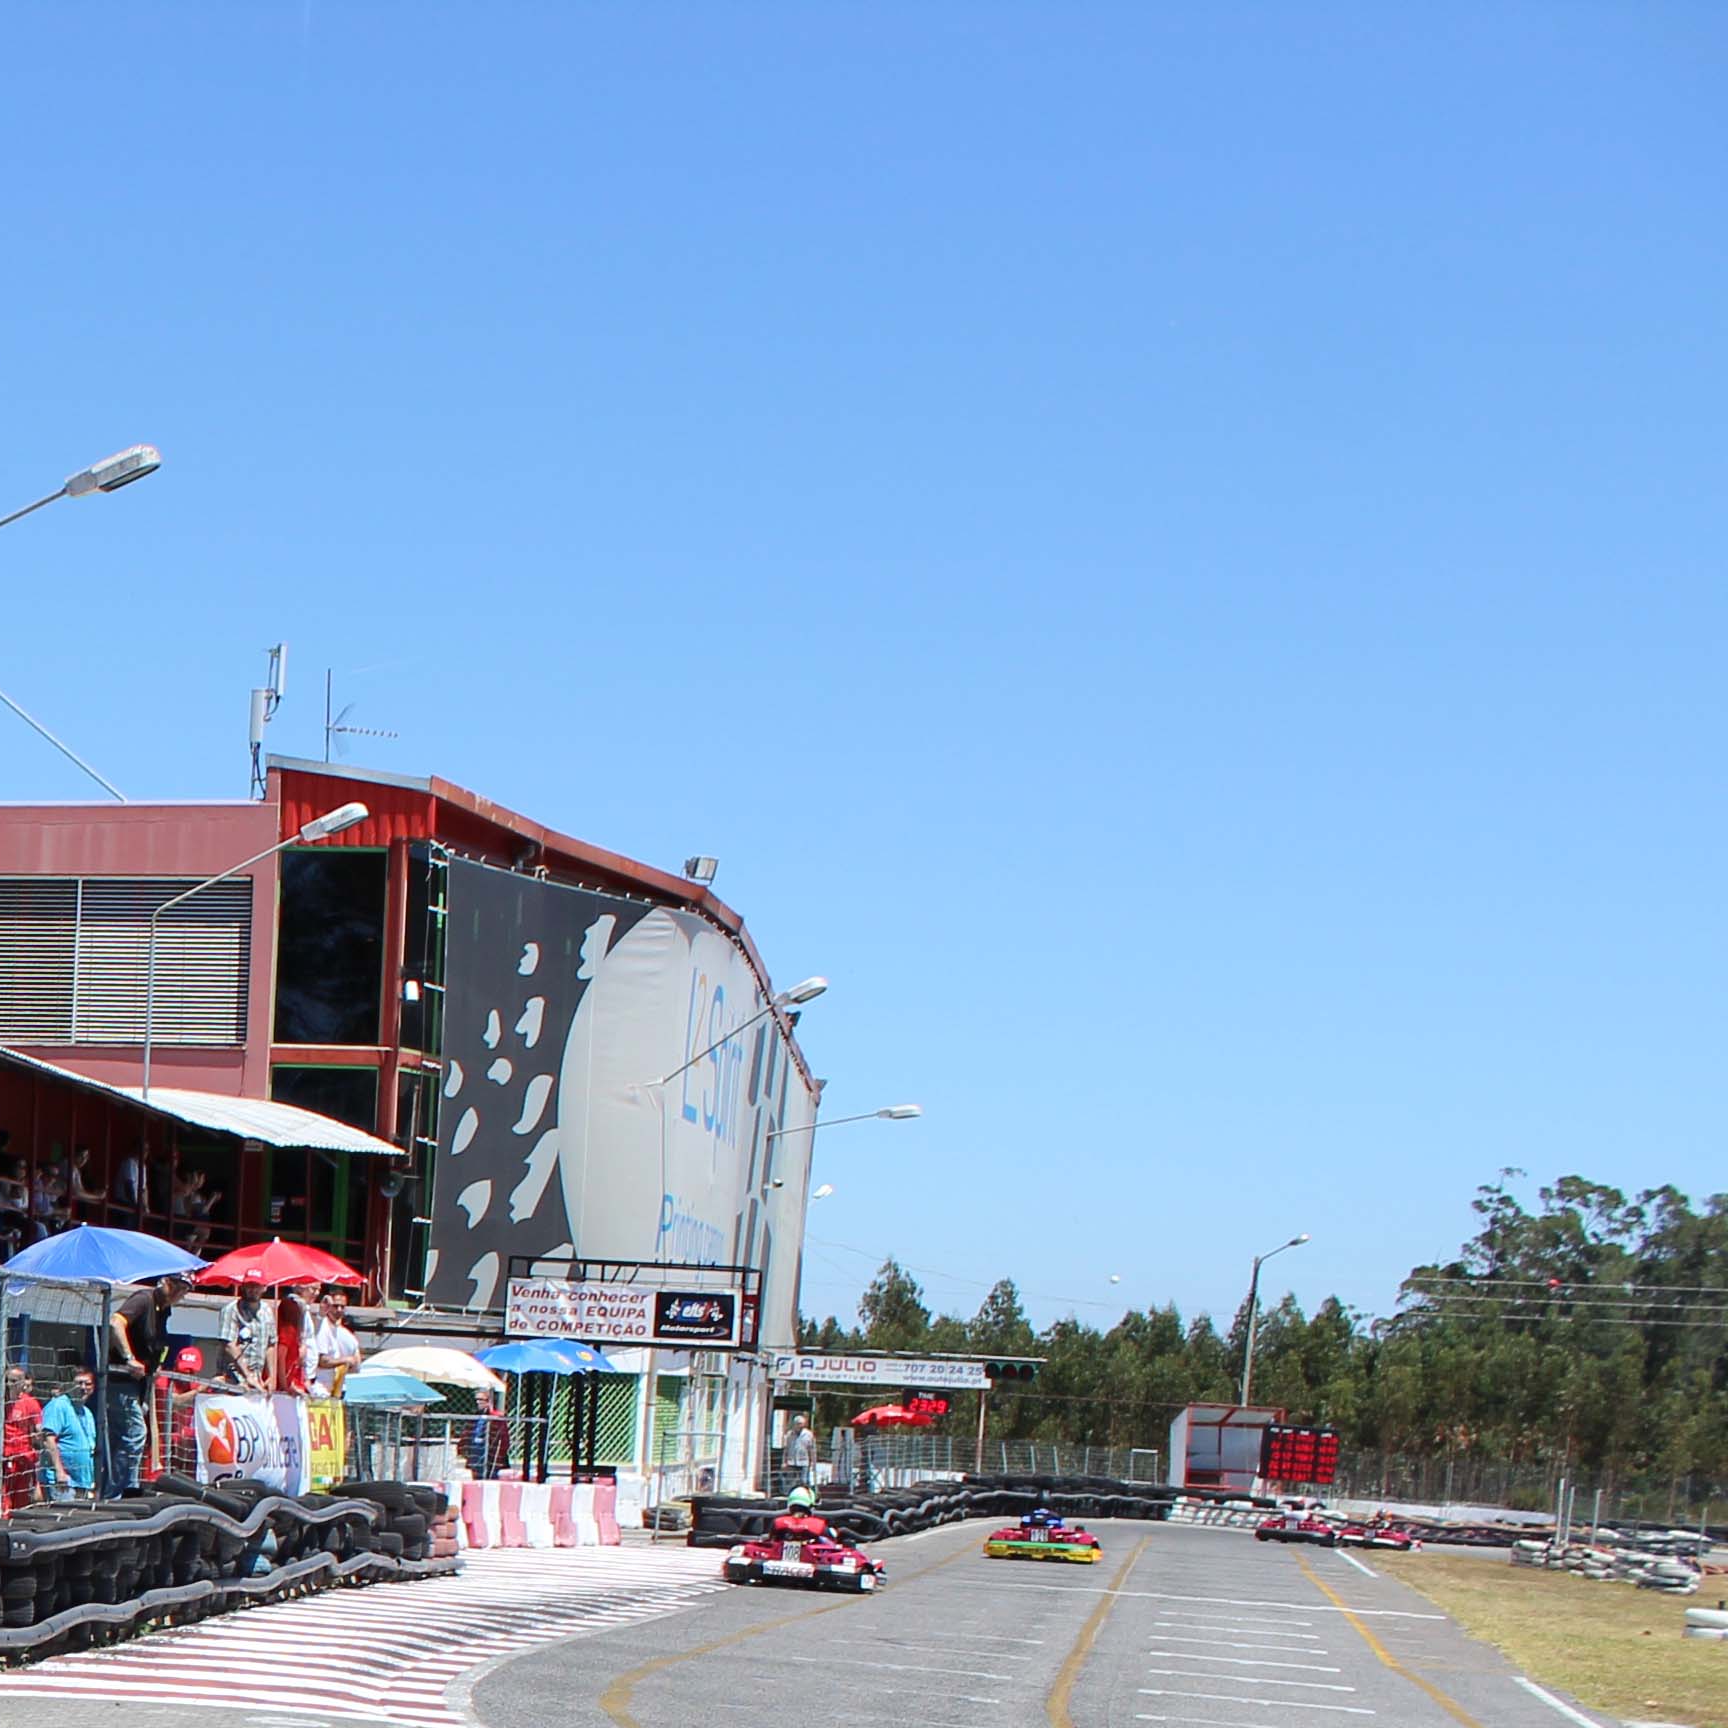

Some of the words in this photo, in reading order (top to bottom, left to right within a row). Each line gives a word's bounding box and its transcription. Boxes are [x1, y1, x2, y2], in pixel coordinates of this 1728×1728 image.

[511, 1285, 559, 1300] Venha
[568, 1289, 647, 1304] conhecer
[511, 1303, 521, 1313] a
[528, 1304, 577, 1316] nossa
[586, 1305, 646, 1319] EQUIPA
[509, 1318, 527, 1330] de
[536, 1319, 647, 1336] COMPETIÇÃO
[660, 1324, 715, 1334] Motorsport
[904, 1364, 926, 1373] 707
[929, 1365, 944, 1374] 20
[949, 1366, 963, 1375] 24
[967, 1367, 982, 1376] 25
